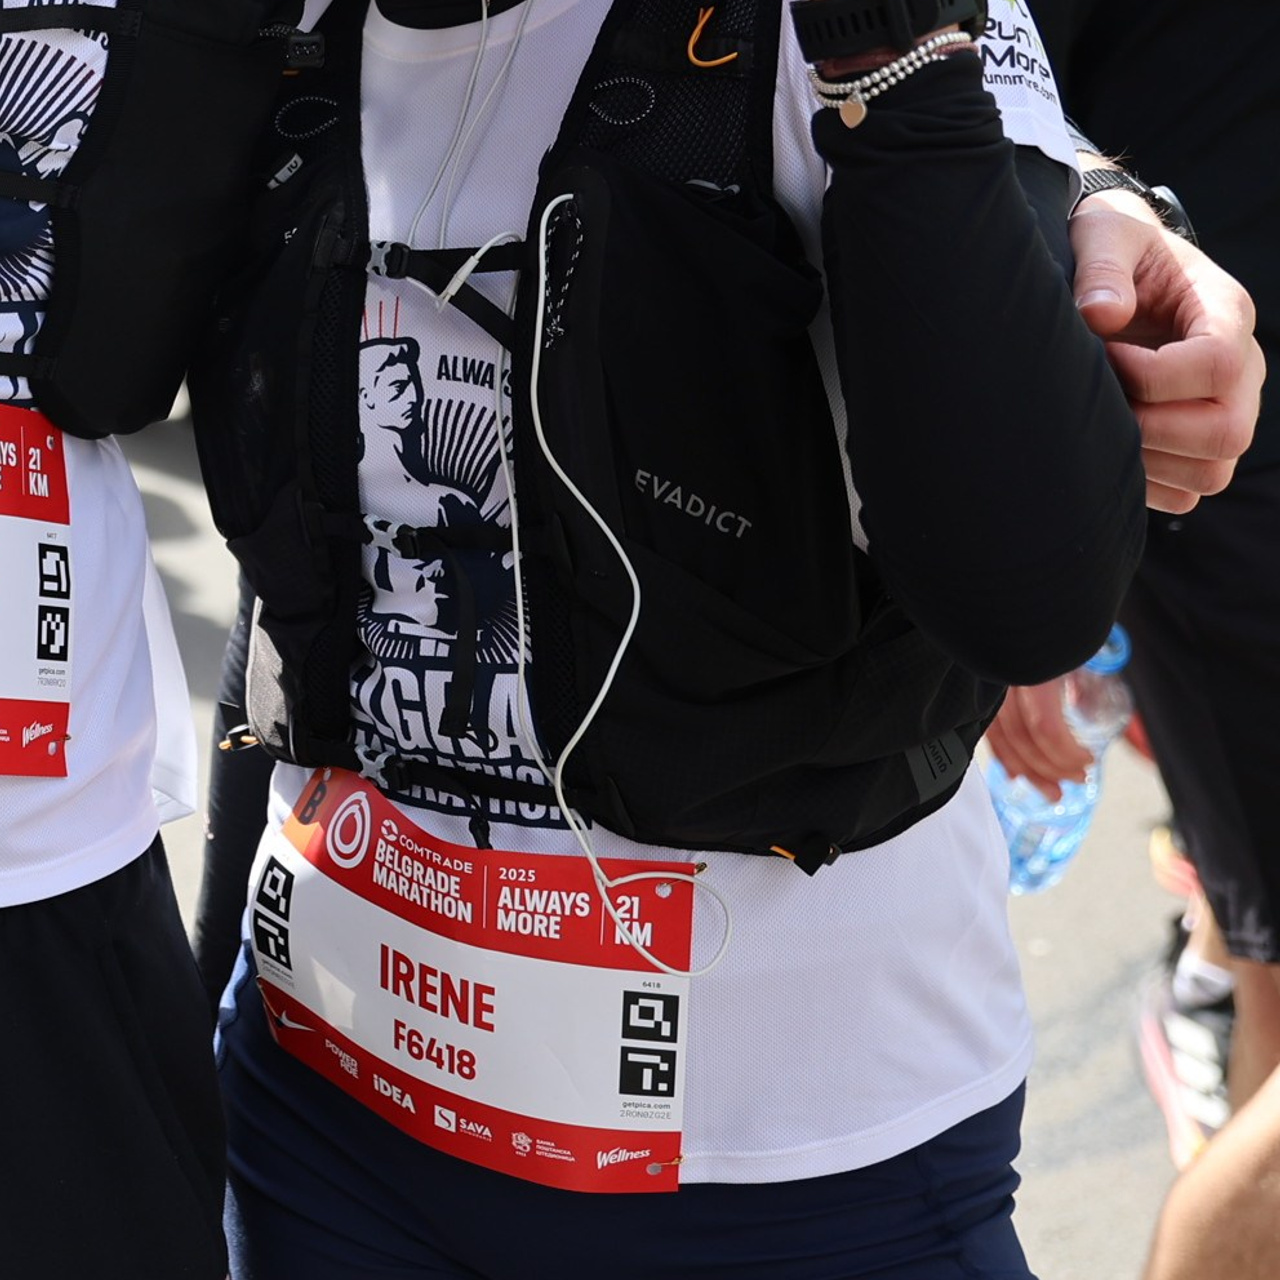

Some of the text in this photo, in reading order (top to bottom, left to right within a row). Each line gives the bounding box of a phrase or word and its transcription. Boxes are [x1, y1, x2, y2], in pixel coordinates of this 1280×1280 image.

[28, 446, 42, 470] 21
[29, 471, 49, 498] KM
[635, 468, 753, 539] EVADICT
[22, 719, 54, 749] Wellness
[298, 780, 328, 826] B
[374, 837, 461, 899] BELGRADE
[399, 833, 474, 875] COMTRADE
[498, 866, 536, 883] 2025
[372, 861, 472, 924] MARATHON
[497, 885, 591, 918] ALWAYS
[615, 894, 640, 920] 21
[496, 909, 561, 940] MORE
[614, 921, 653, 947] KM
[380, 942, 496, 1034] IRENE
[642, 980, 662, 989] 6418
[325, 1038, 359, 1070] POWER
[393, 1018, 477, 1082] F6418
[622, 1100, 672, 1111] getpica.com
[459, 1117, 493, 1139] SAVA
[596, 1146, 652, 1170] Wellness
